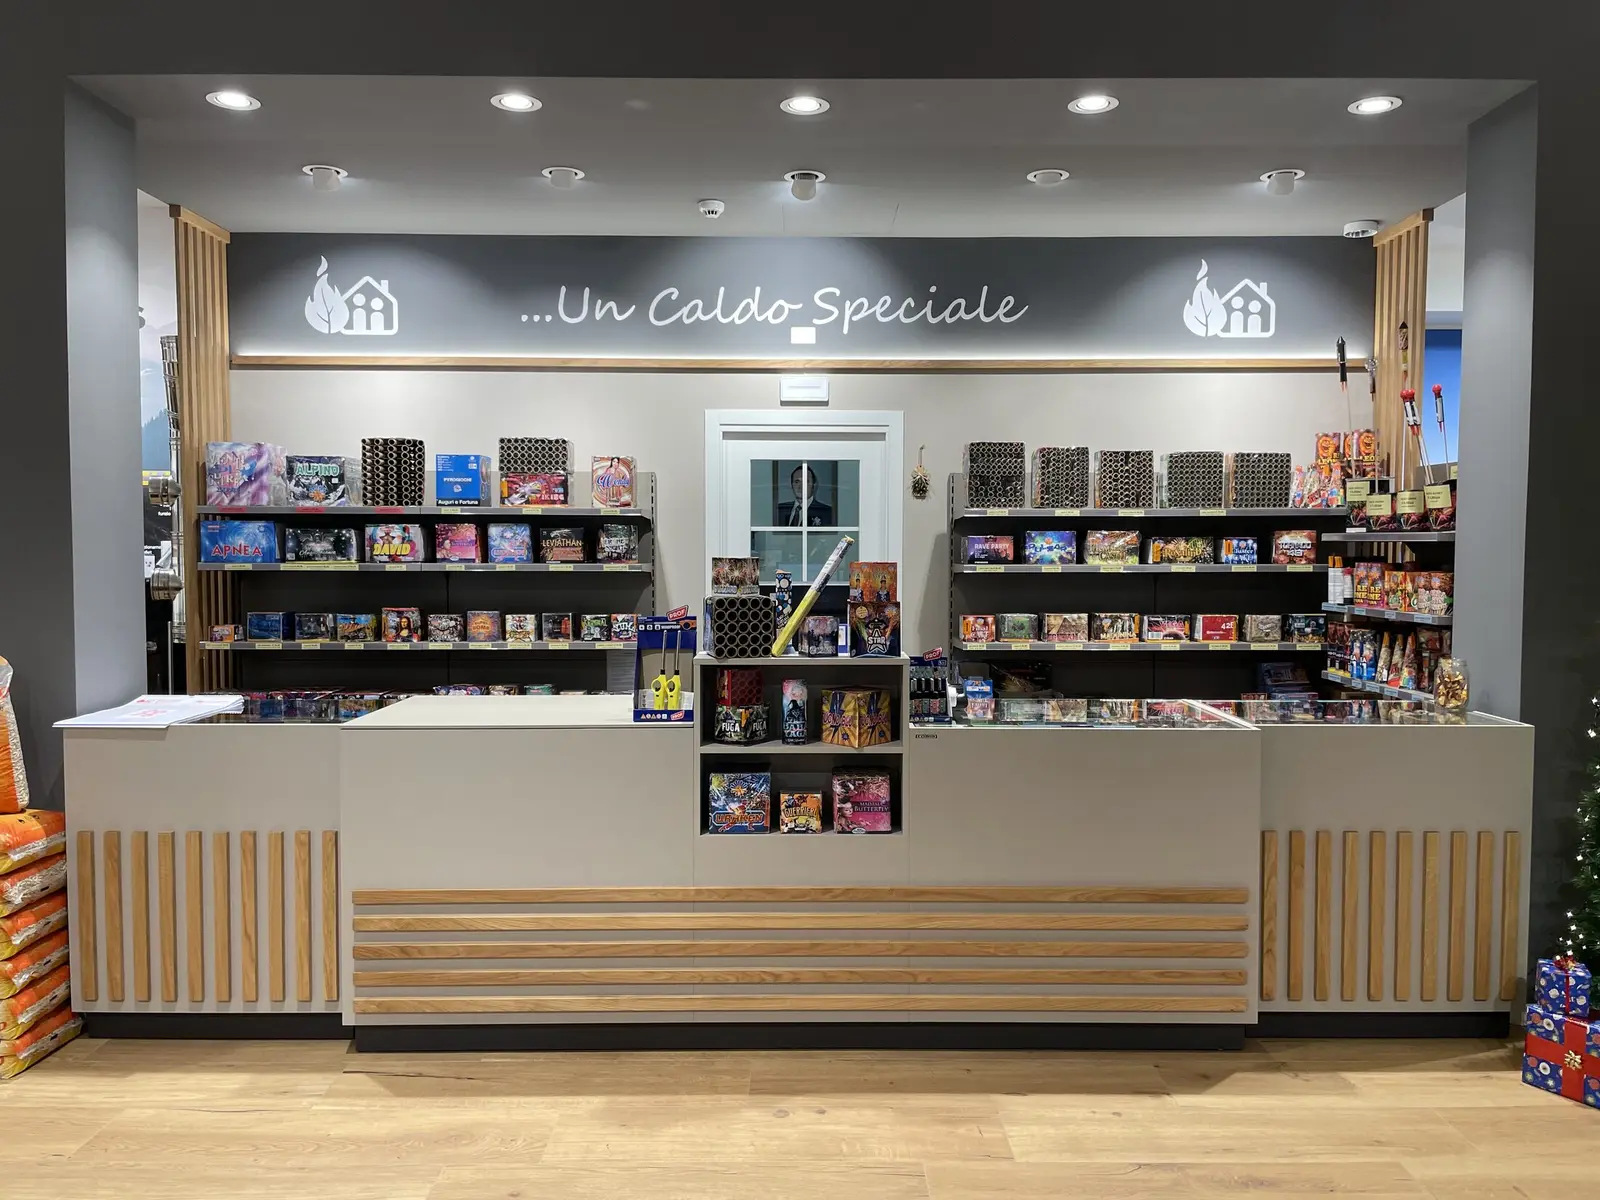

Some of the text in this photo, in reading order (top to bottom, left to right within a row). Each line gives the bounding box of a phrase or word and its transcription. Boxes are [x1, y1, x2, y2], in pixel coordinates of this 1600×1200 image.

[648, 286, 803, 326] Caldo
[812, 285, 1029, 334] Speciale
[296, 463, 340, 476] ALPINO
[542, 539, 582, 547] LEVIATHAN
[1028, 543, 1068, 552] PULSAR
[211, 542, 263, 560] APNEA
[373, 543, 411, 555] DAVID
[669, 608, 686, 619] PROF
[868, 637, 886, 645] STAR
[925, 651, 940, 659] PROF
[721, 722, 740, 732] FUGA
[753, 721, 767, 731] FUGA
